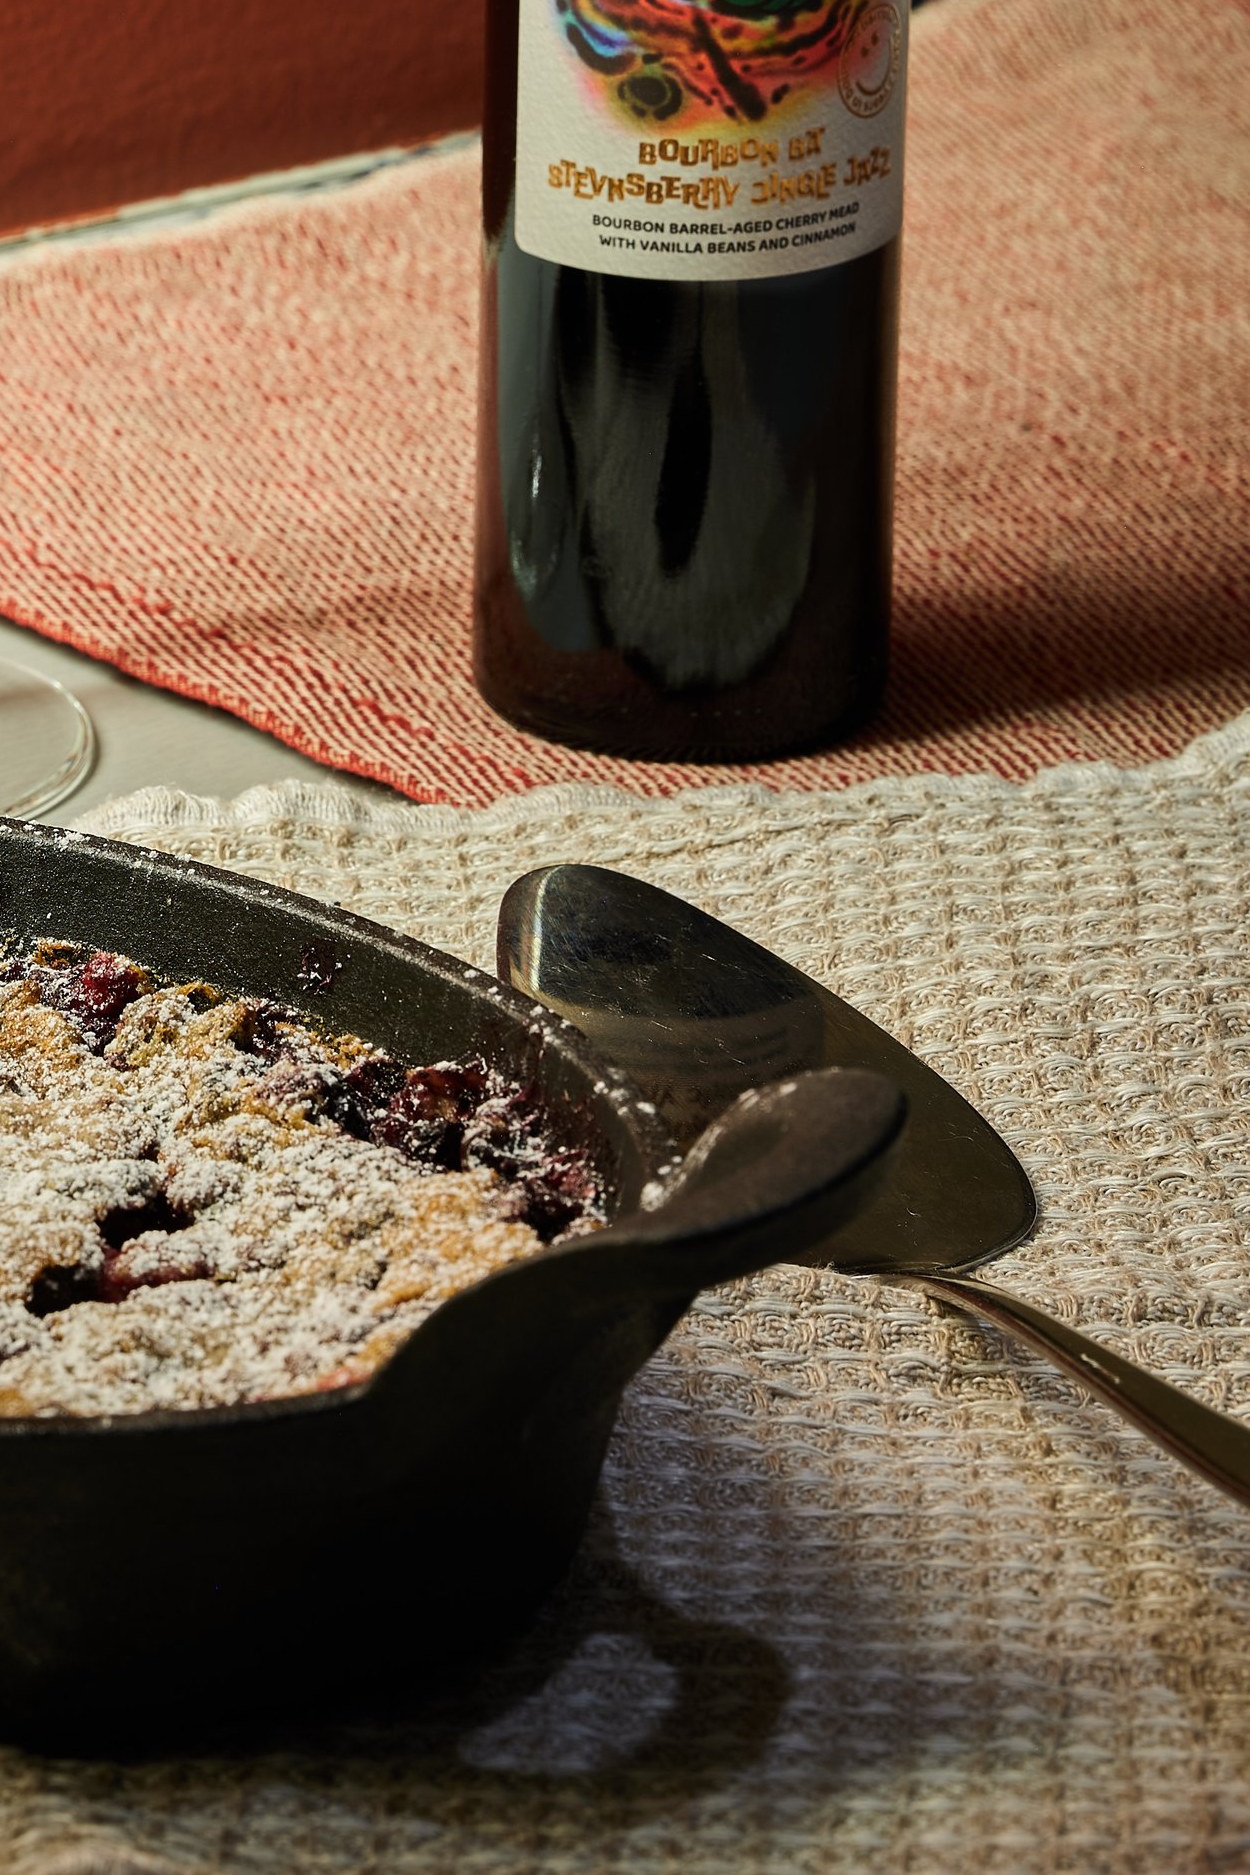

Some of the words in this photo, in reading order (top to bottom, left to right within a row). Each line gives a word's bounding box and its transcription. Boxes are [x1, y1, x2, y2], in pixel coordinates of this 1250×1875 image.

[639, 138, 779, 171] BOURBON
[548, 159, 740, 210] STEVNSBERRY
[750, 163, 837, 205] JINGLE
[843, 145, 891, 186] JAZZ
[592, 214, 665, 233] BOURBON
[669, 219, 772, 235] BARREL-AGED
[775, 211, 827, 231] CHERRY
[828, 201, 860, 220] MEAD
[599, 234, 635, 250] WITH
[640, 240, 703, 254] VANILLA
[707, 240, 756, 254] BEANS
[758, 236, 789, 251] AND
[791, 221, 857, 246] CINNAMON
